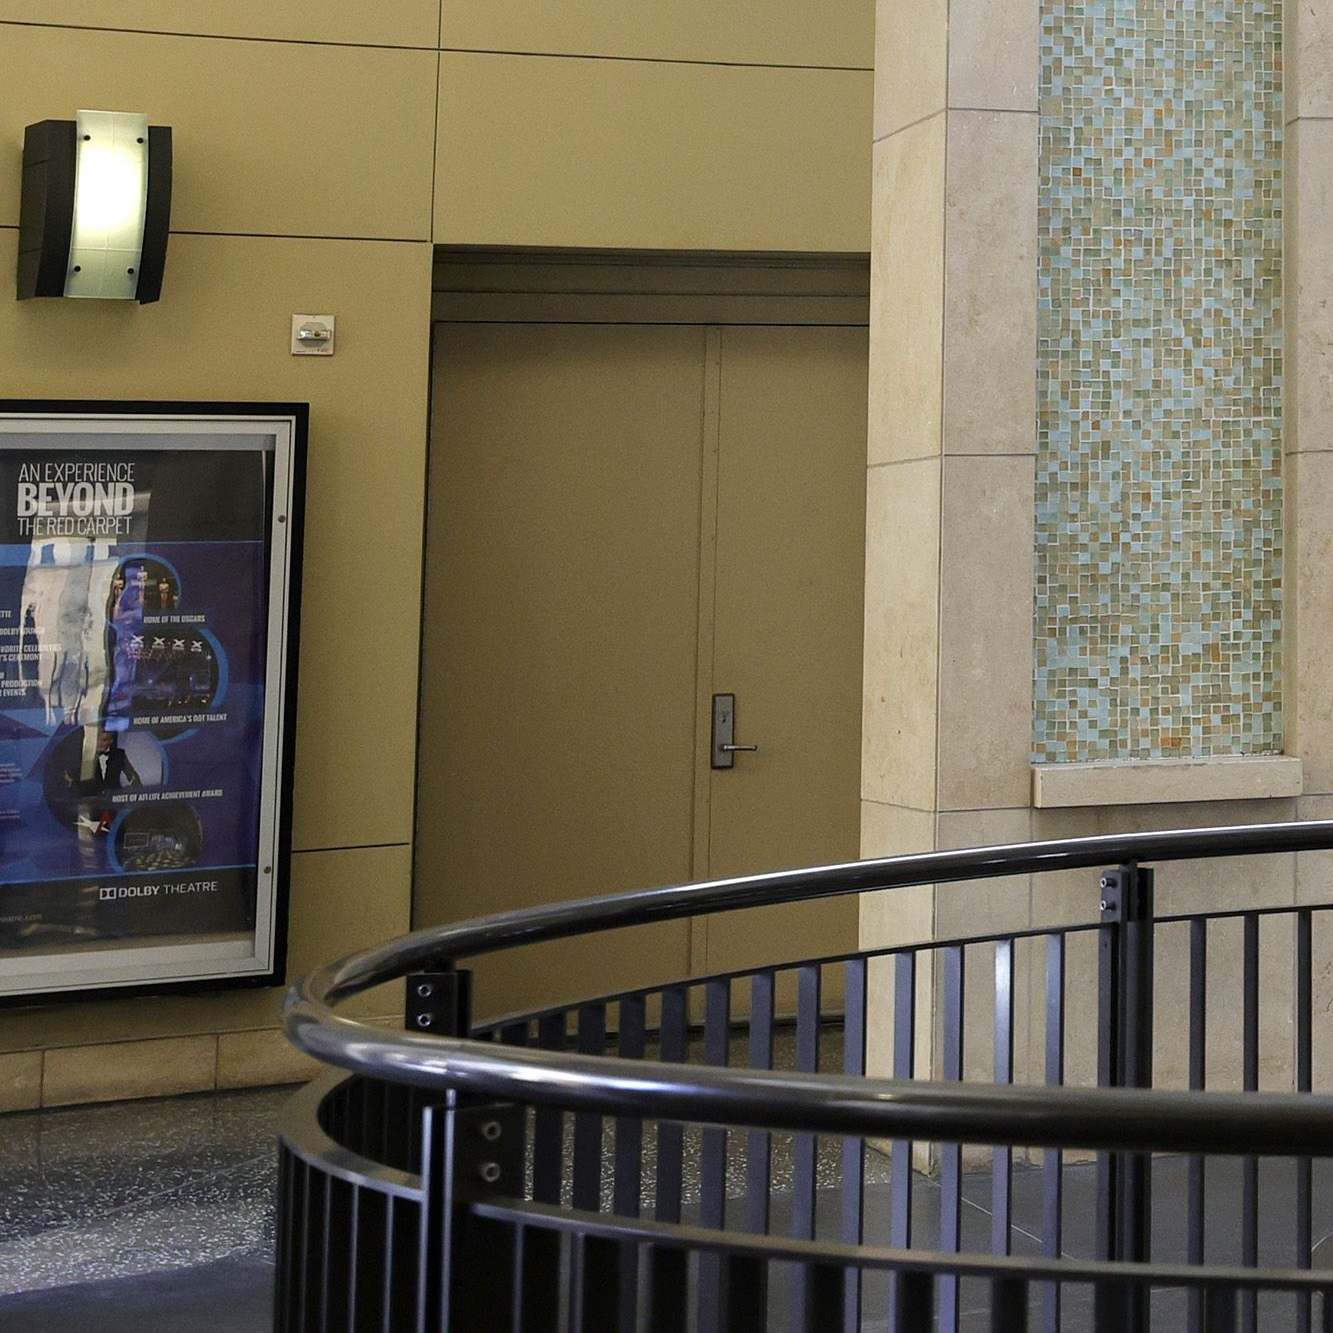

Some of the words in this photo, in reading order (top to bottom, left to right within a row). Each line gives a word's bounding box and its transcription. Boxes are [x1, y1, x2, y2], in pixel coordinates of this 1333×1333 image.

[18, 463, 39, 481] AN
[45, 462, 135, 482] EXPERIENCE
[17, 482, 135, 517] BEYOND
[17, 517, 43, 535] THE
[46, 517, 75, 535] RED
[77, 516, 133, 535] CARPET
[170, 615, 180, 623] THE
[181, 615, 205, 623] OSCARS
[133, 716, 150, 725] HOME
[160, 714, 192, 724] AMERICA'S
[193, 714, 205, 722] GOT
[206, 713, 227, 722] TALENT
[161, 790, 200, 800] ACHIEVEMENT
[118, 885, 160, 898] DOLBY
[163, 881, 219, 895] THEATRE
